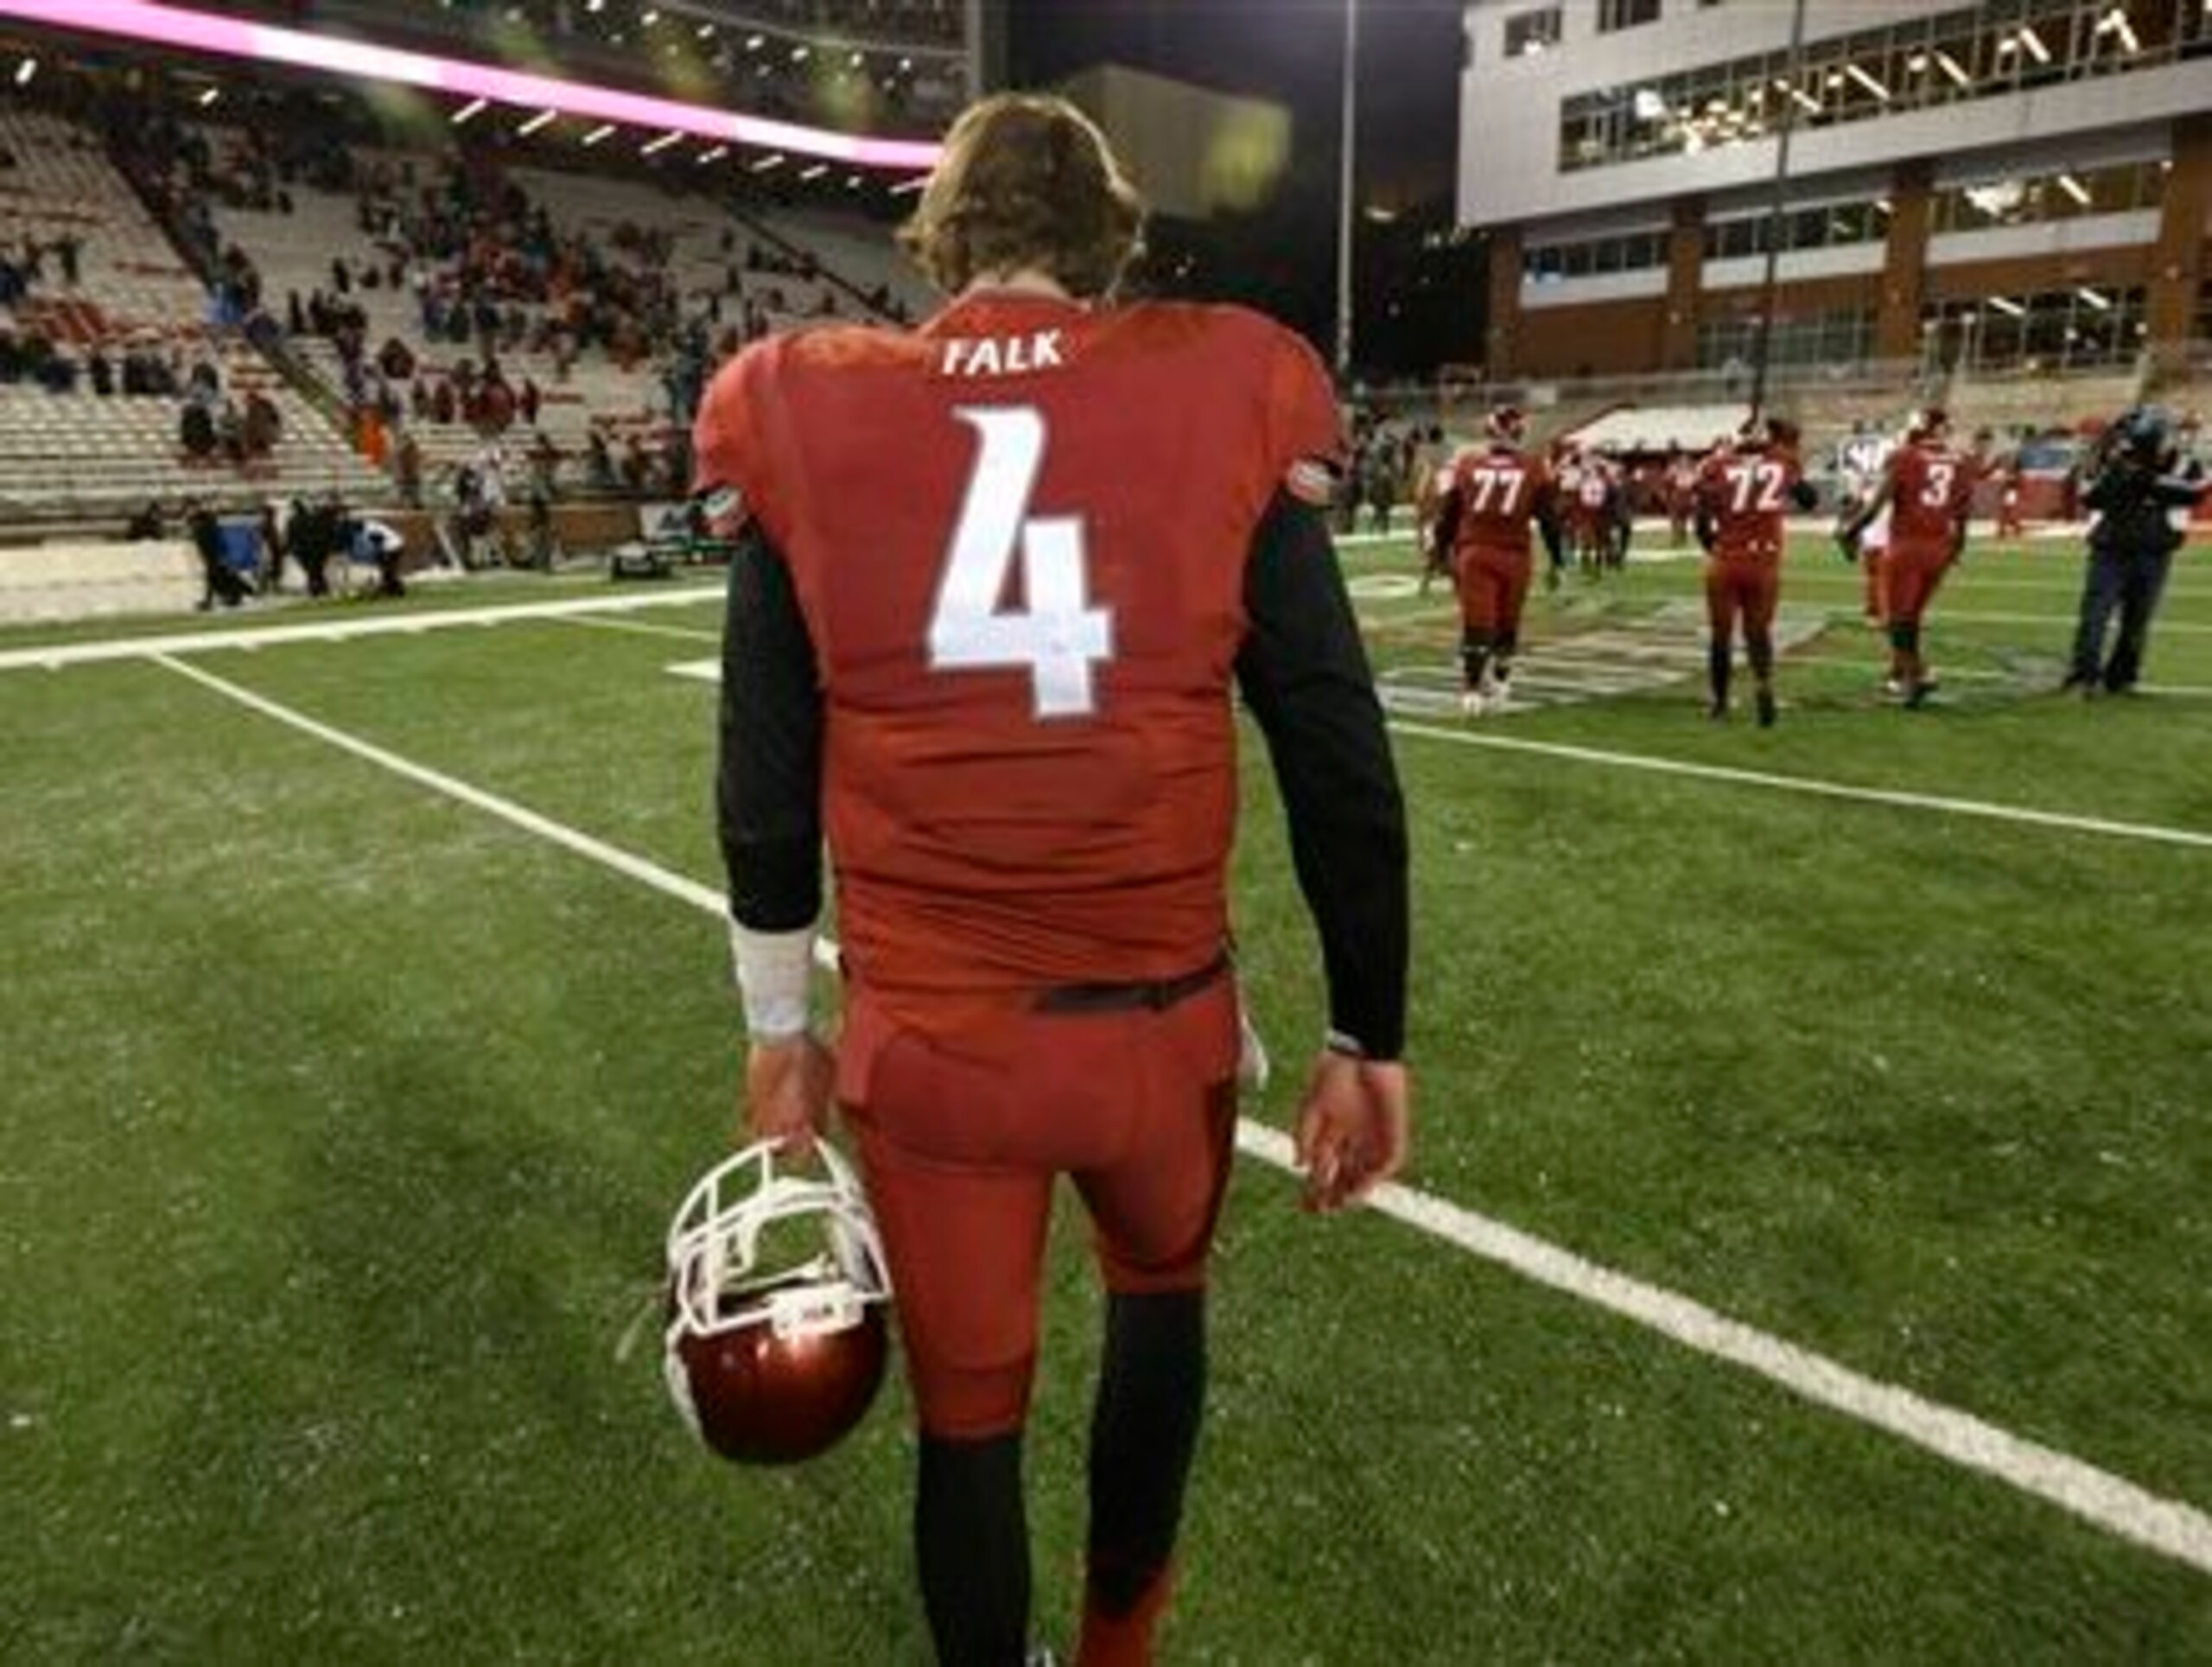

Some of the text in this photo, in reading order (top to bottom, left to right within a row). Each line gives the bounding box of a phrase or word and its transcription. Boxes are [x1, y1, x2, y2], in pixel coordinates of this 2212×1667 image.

[943, 328, 1063, 375] FALK
[1473, 468, 1524, 514] 77
[1726, 463, 1783, 512] 72
[1922, 464, 1955, 506] 3
[929, 404, 1114, 716] 4
